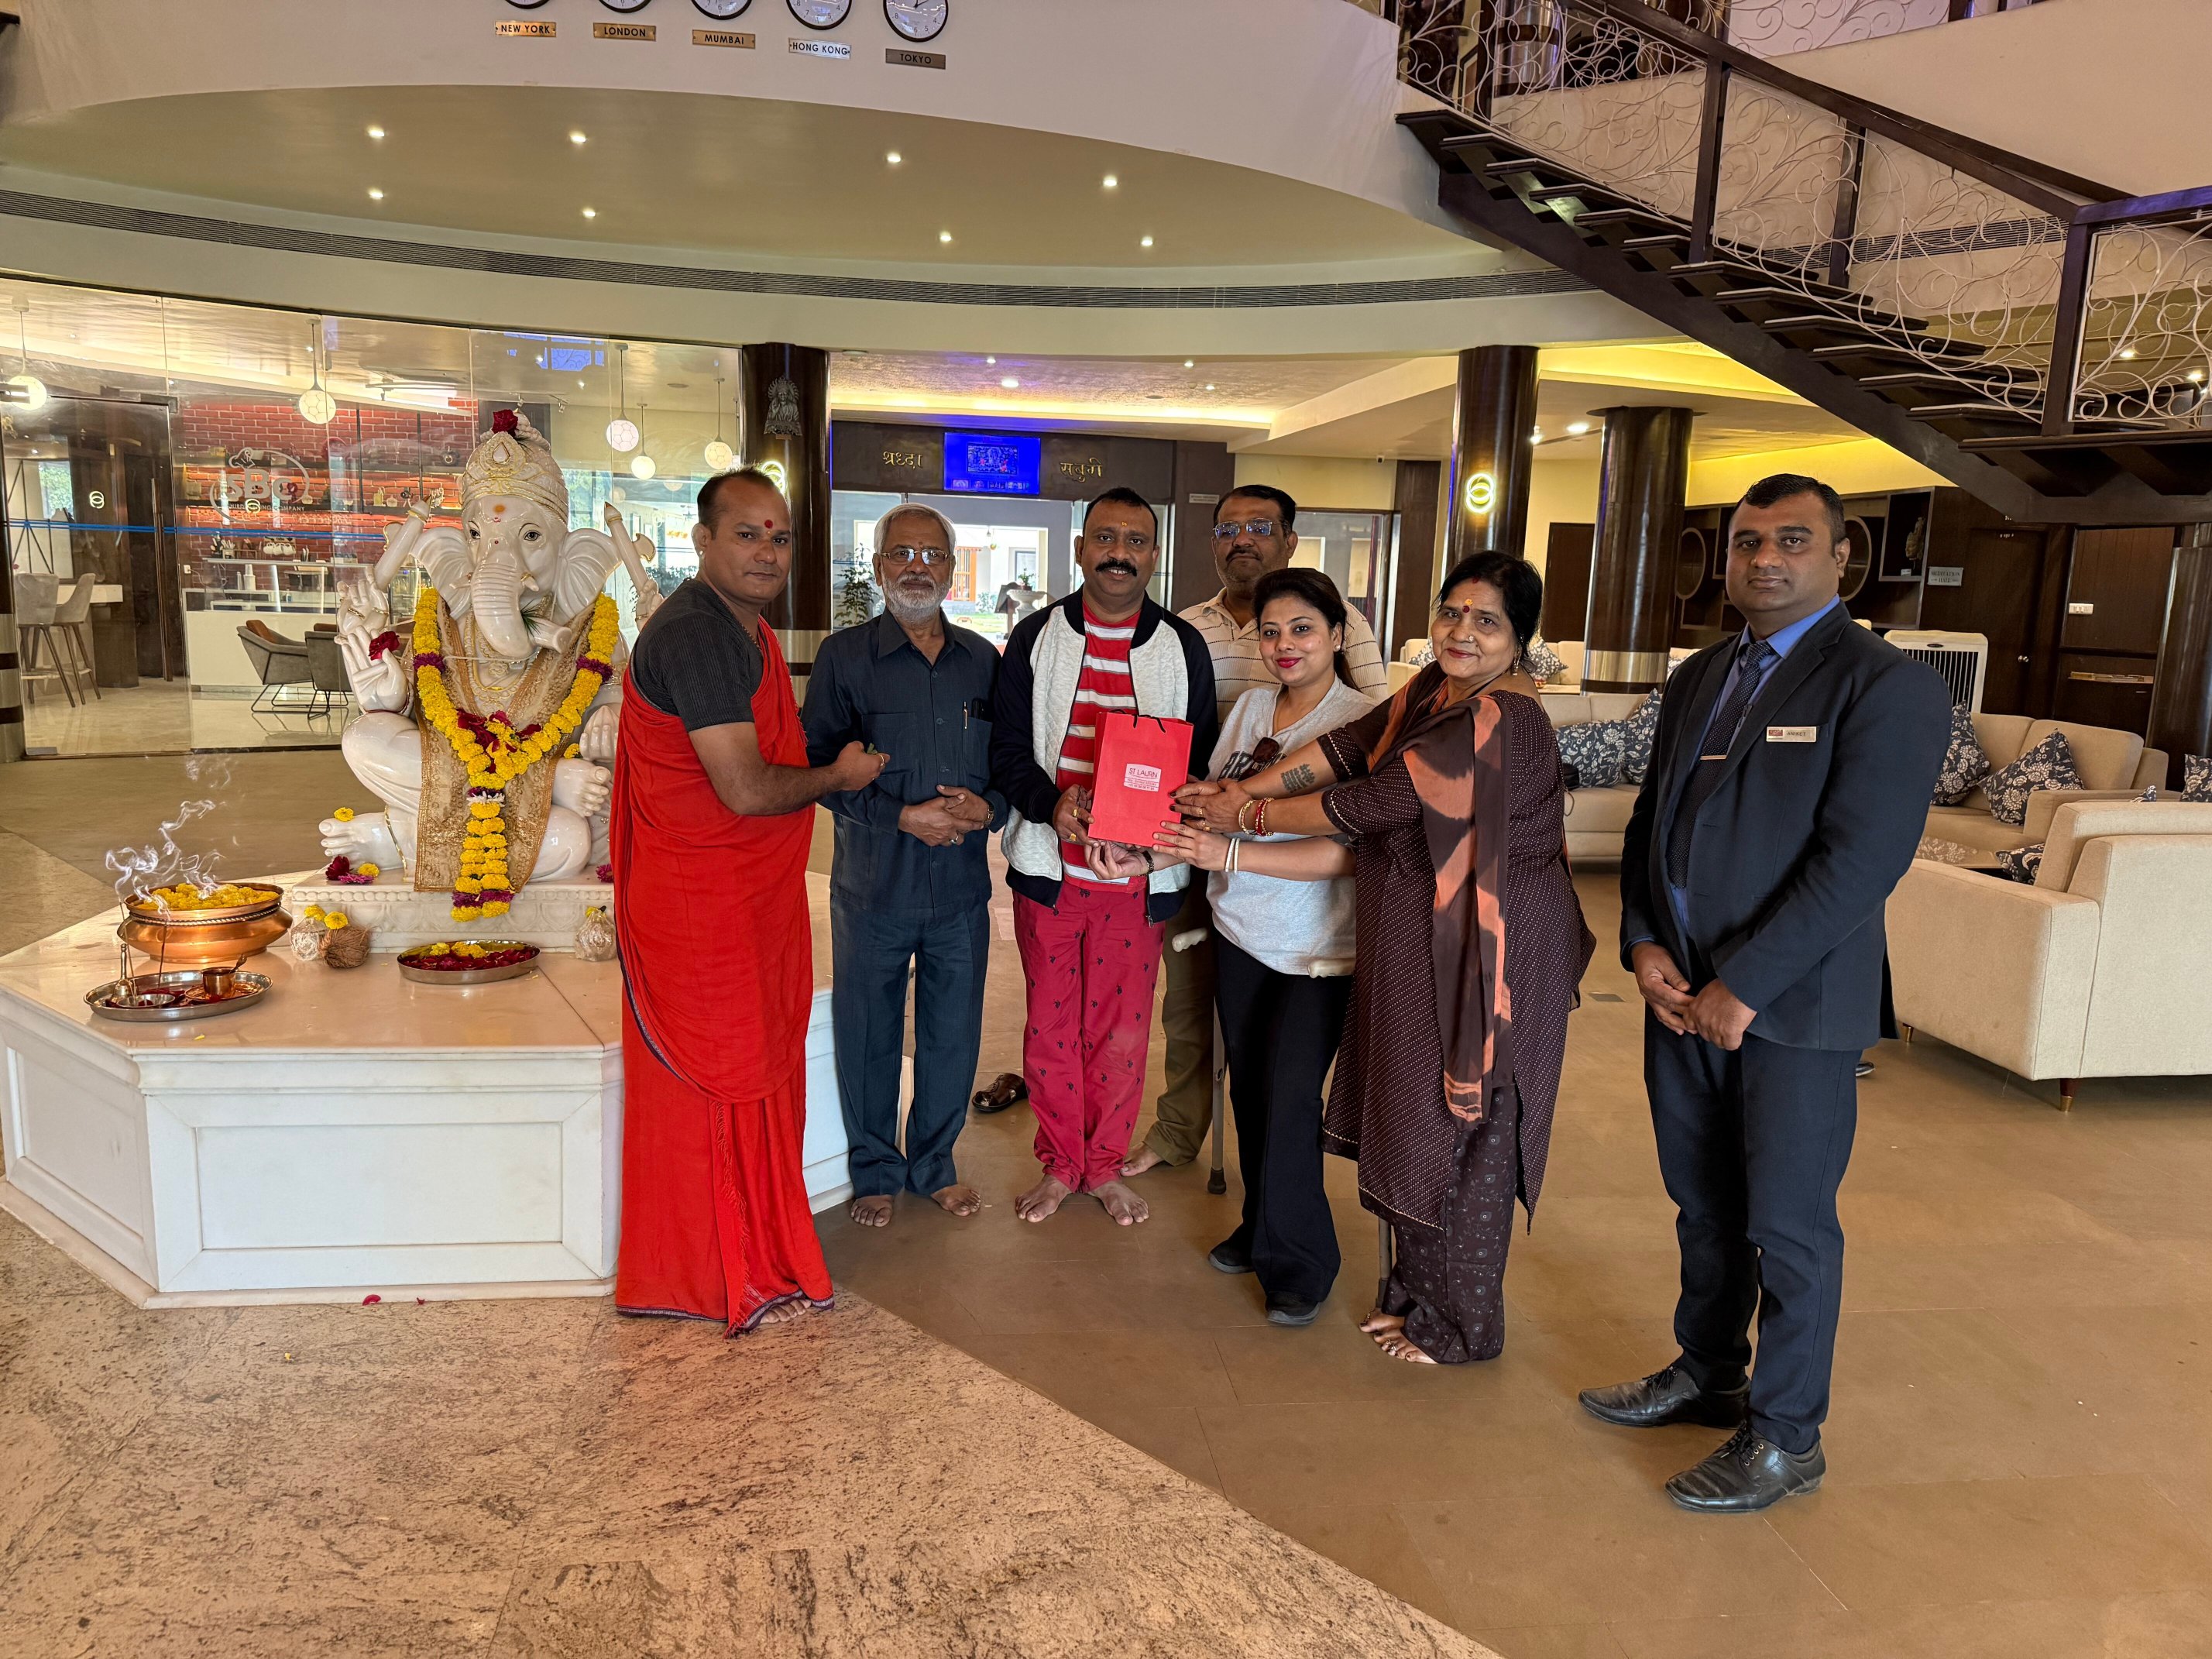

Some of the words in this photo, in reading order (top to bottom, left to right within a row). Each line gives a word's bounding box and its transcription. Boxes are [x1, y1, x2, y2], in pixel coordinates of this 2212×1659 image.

[500, 24, 521, 33] NEW
[524, 25, 551, 33] YORK
[604, 26, 646, 37] LONDON
[704, 34, 744, 45] MUMBAI
[792, 42, 819, 52] HONG
[822, 45, 847, 55] KONG
[900, 53, 932, 64] TOKYO
[1137, 769, 1158, 778] LAURN
